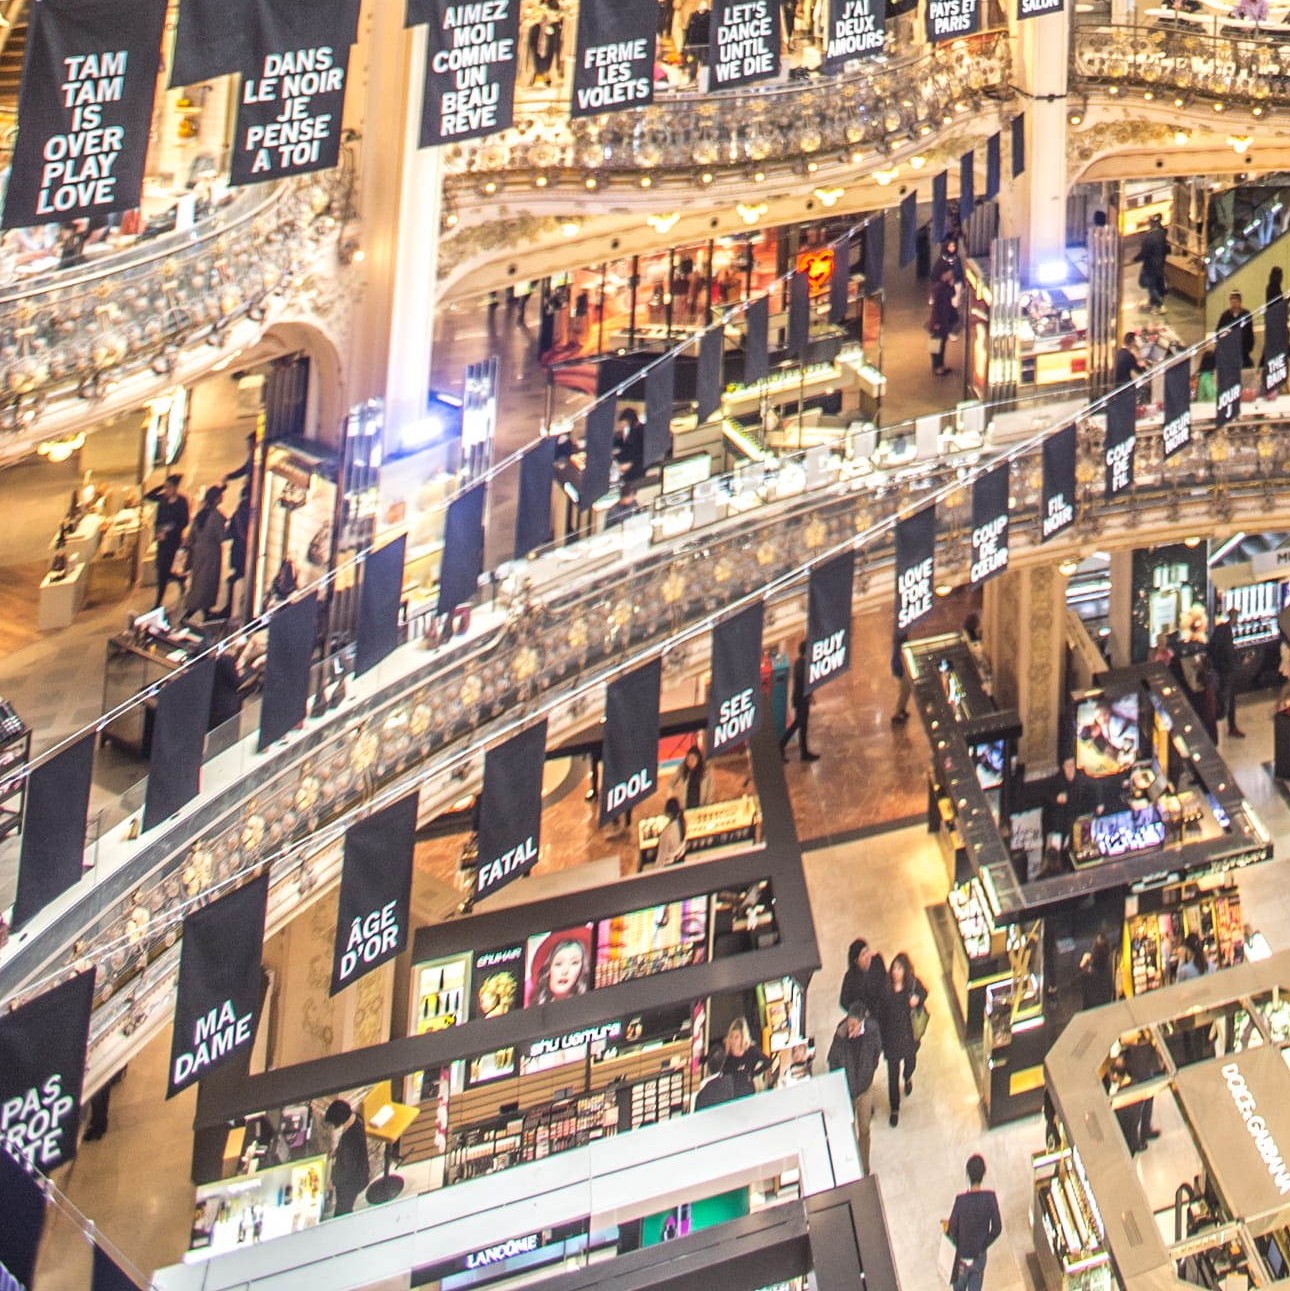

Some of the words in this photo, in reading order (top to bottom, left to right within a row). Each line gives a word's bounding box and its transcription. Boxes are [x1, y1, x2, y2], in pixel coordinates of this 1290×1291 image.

[724, 1, 766, 25] LET'S
[842, 0, 871, 19] J'AI
[930, 0, 959, 19] PAYS
[935, 13, 970, 34] PARIS
[718, 17, 772, 45] DANCE
[836, 15, 874, 38] DEUX
[585, 39, 647, 69] FERME
[720, 37, 768, 62] UNTIL
[827, 29, 885, 58] AMOURS
[64, 52, 125, 81] TAM
[264, 47, 331, 77] DANS
[598, 62, 630, 86] LES
[716, 60, 741, 82] WE
[744, 53, 773, 76] DIE
[62, 77, 121, 107] TAM
[244, 78, 277, 104] LE
[282, 69, 342, 98] NOIR
[578, 78, 649, 108] VOLETS
[72, 105, 101, 131] IS
[277, 97, 309, 122] JE
[44, 127, 123, 160] OVER
[246, 115, 330, 150] PENSE
[42, 152, 117, 187] PLAY
[279, 140, 319, 167] TOI
[36, 178, 116, 214] LOVE
[898, 557, 933, 592] LOVE
[901, 578, 930, 609] FOR
[898, 593, 933, 629] SALE
[811, 629, 847, 661] BUY
[808, 645, 846, 685] NOW
[720, 689, 753, 723] SEE
[714, 707, 755, 747] NOW
[607, 769, 652, 811] IDOL
[478, 837, 537, 891] FATAL
[347, 901, 398, 953] ÂGE
[340, 926, 398, 980] D'OR
[195, 1001, 235, 1045] MA
[174, 1009, 253, 1083] DAME
[1, 1074, 62, 1129] PAS
[0, 1095, 74, 1162] ROP
[465, 1234, 538, 1269] LANCÔME
